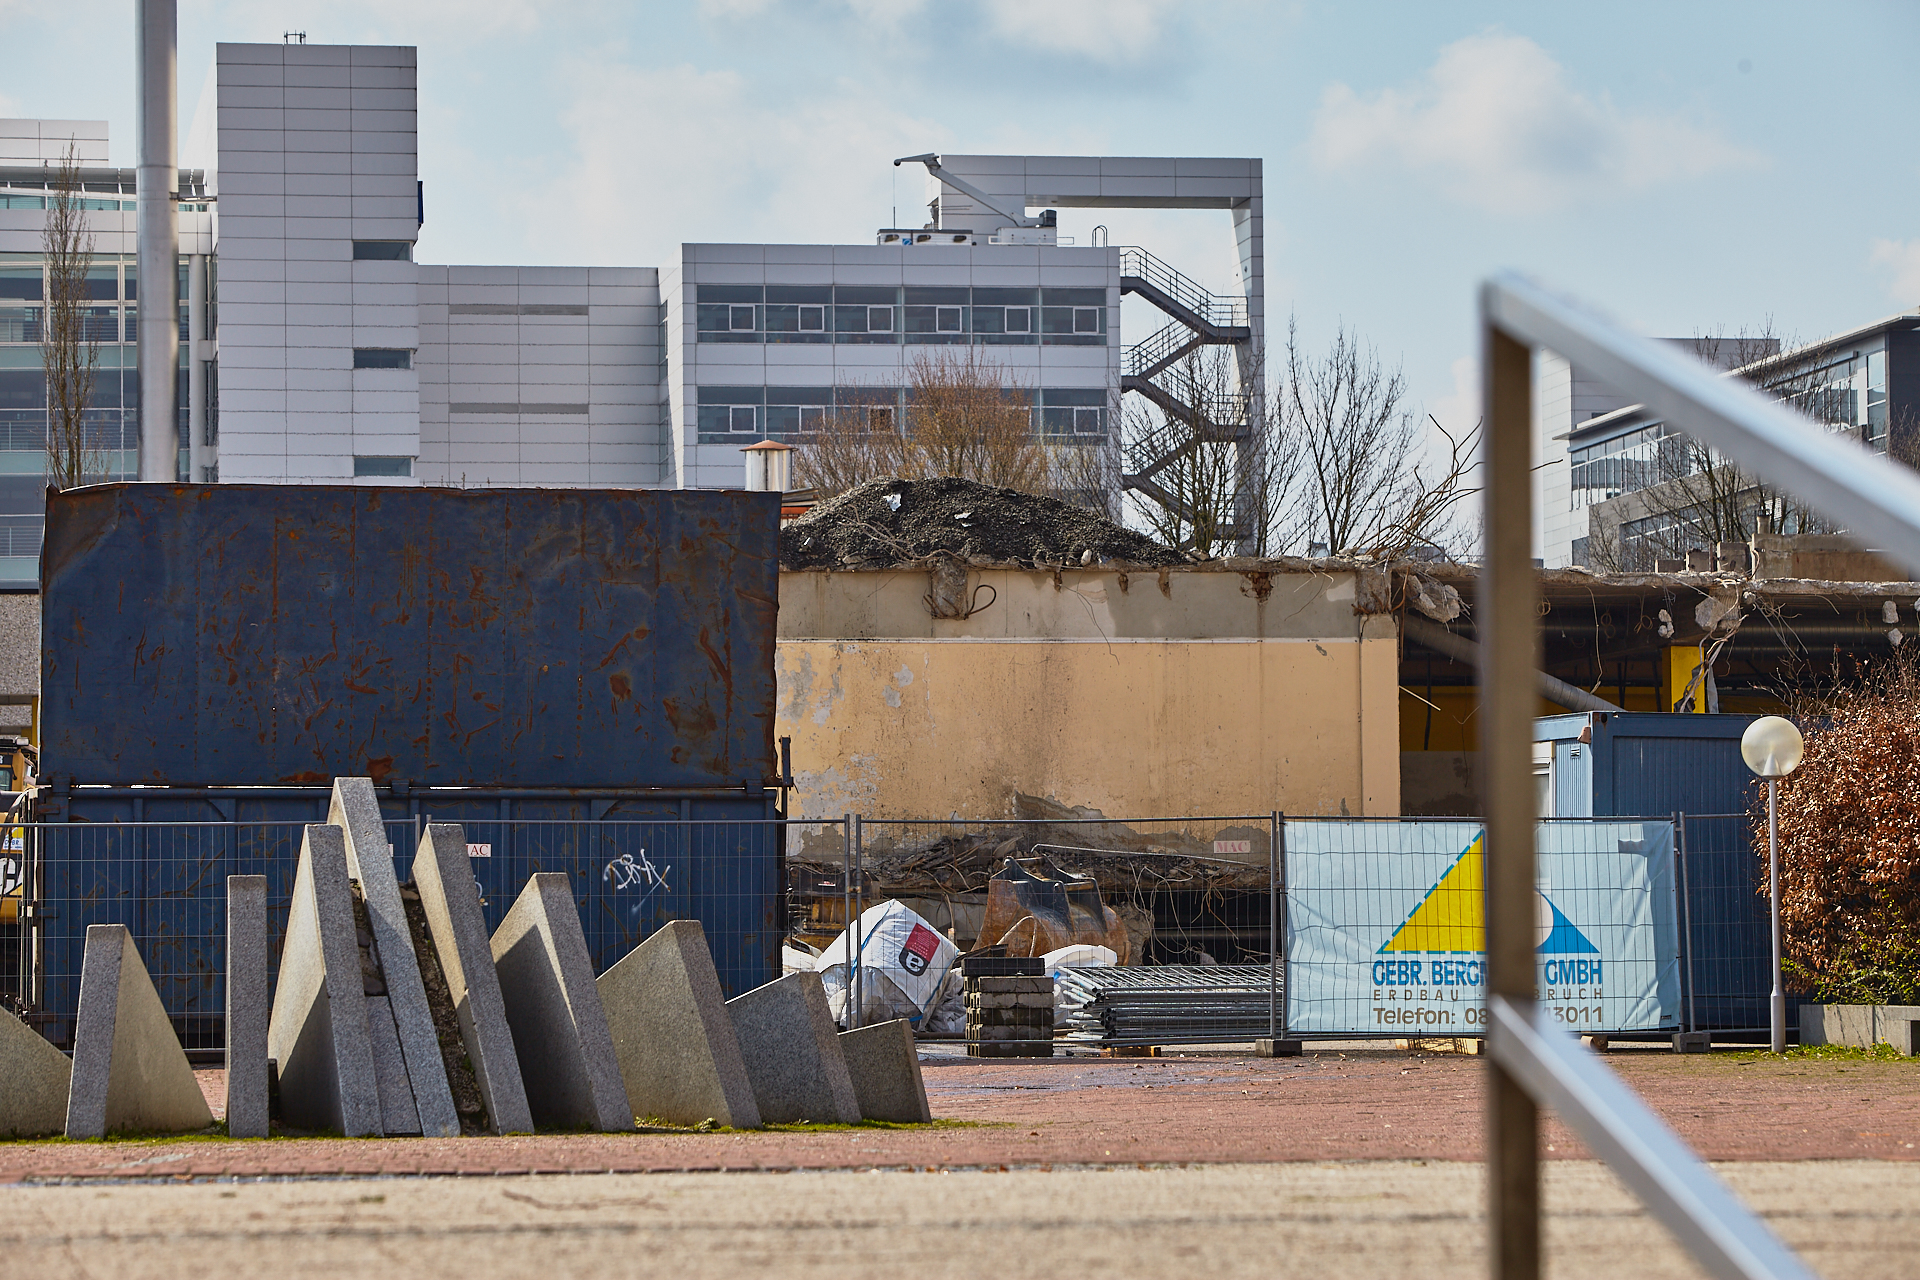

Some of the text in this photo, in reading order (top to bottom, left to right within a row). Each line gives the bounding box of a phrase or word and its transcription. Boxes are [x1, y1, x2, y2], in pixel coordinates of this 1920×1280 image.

[1216, 842, 1247, 852] MAC
[1373, 960, 1427, 986] GEBR.
[1545, 959, 1602, 985] GMBH
[1373, 988, 1602, 1001] ERDBAU BRUCH
[1373, 1007, 1455, 1024] Telefon:
